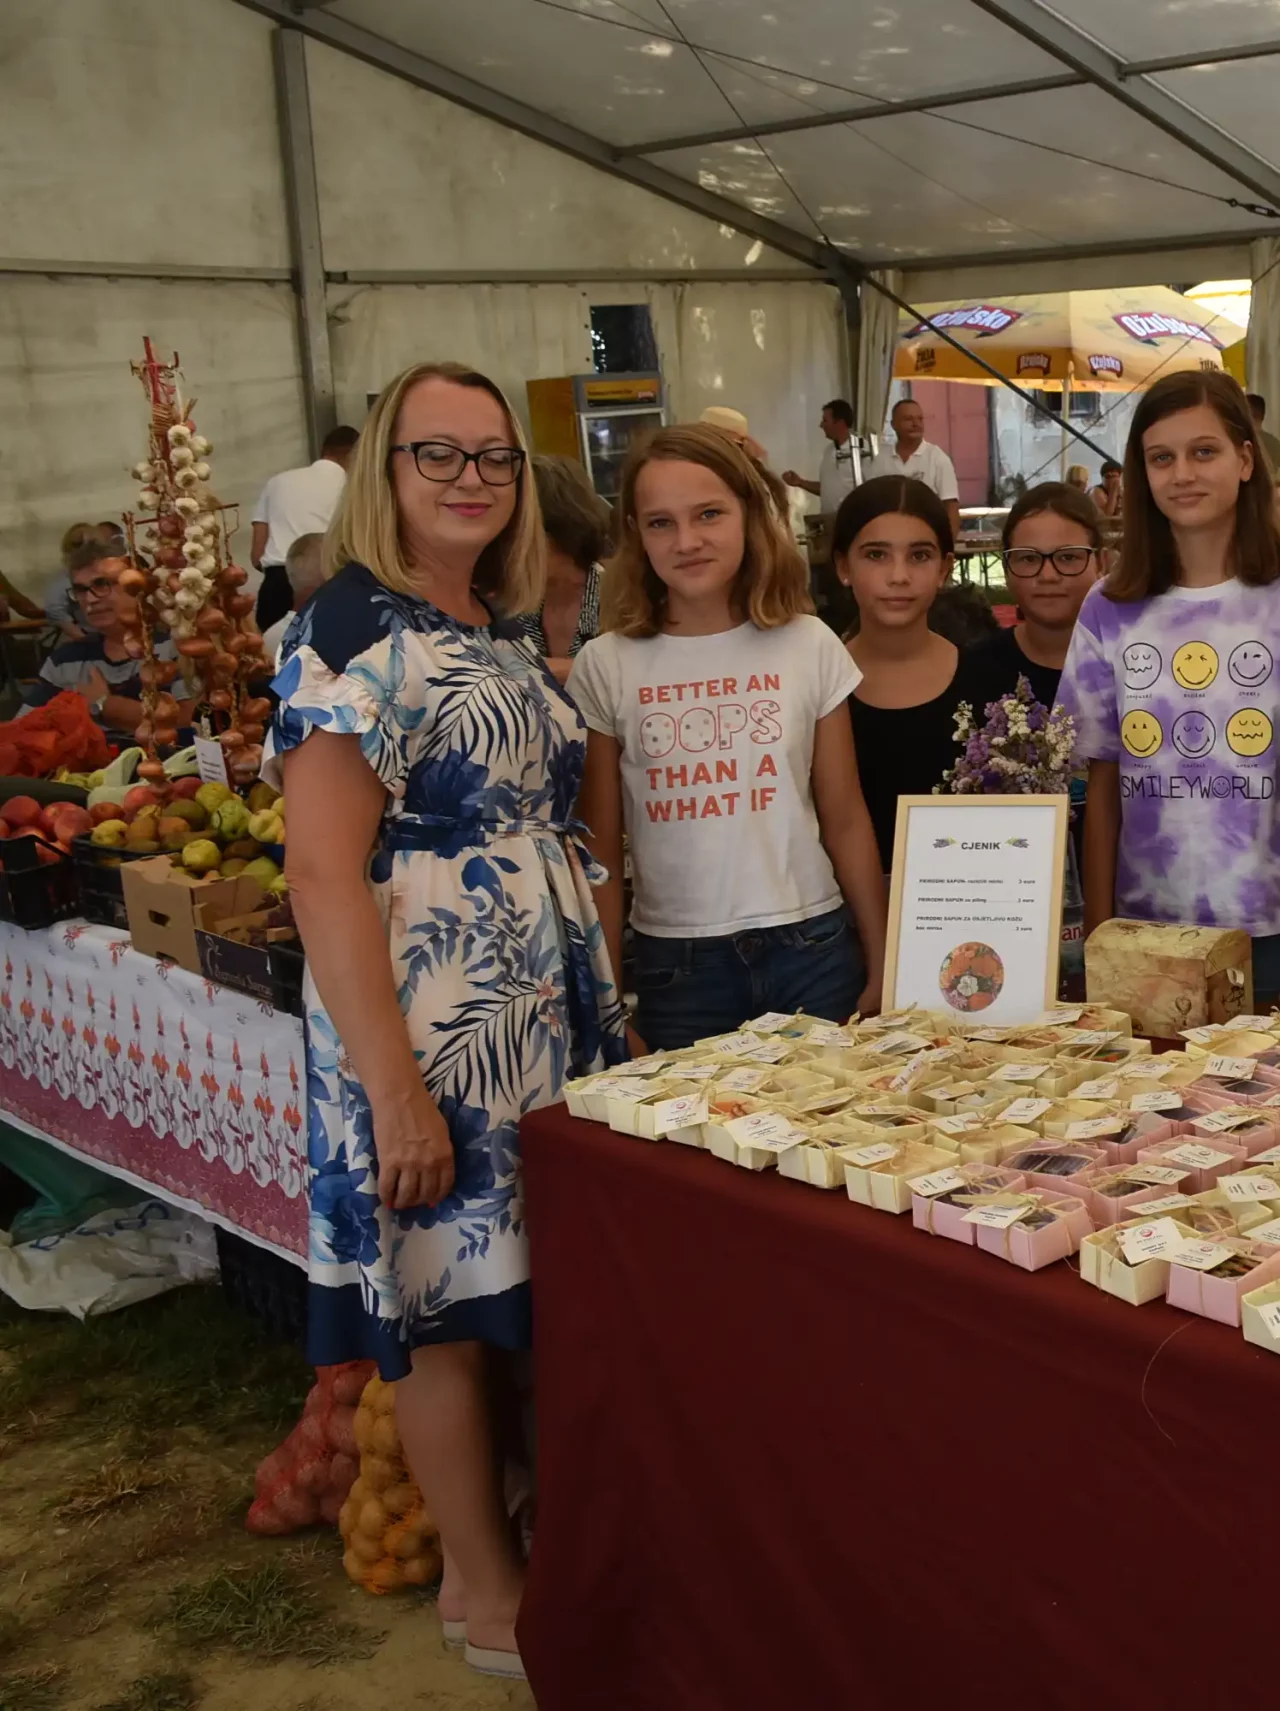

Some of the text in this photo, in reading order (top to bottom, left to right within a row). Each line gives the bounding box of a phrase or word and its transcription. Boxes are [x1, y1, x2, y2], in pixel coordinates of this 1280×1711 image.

[638, 673, 781, 705] BETTER AN
[640, 699, 783, 759] OOPS
[645, 753, 778, 790] THAN A
[645, 787, 777, 823] WHAT IF
[960, 842, 1001, 851] CJENIK
